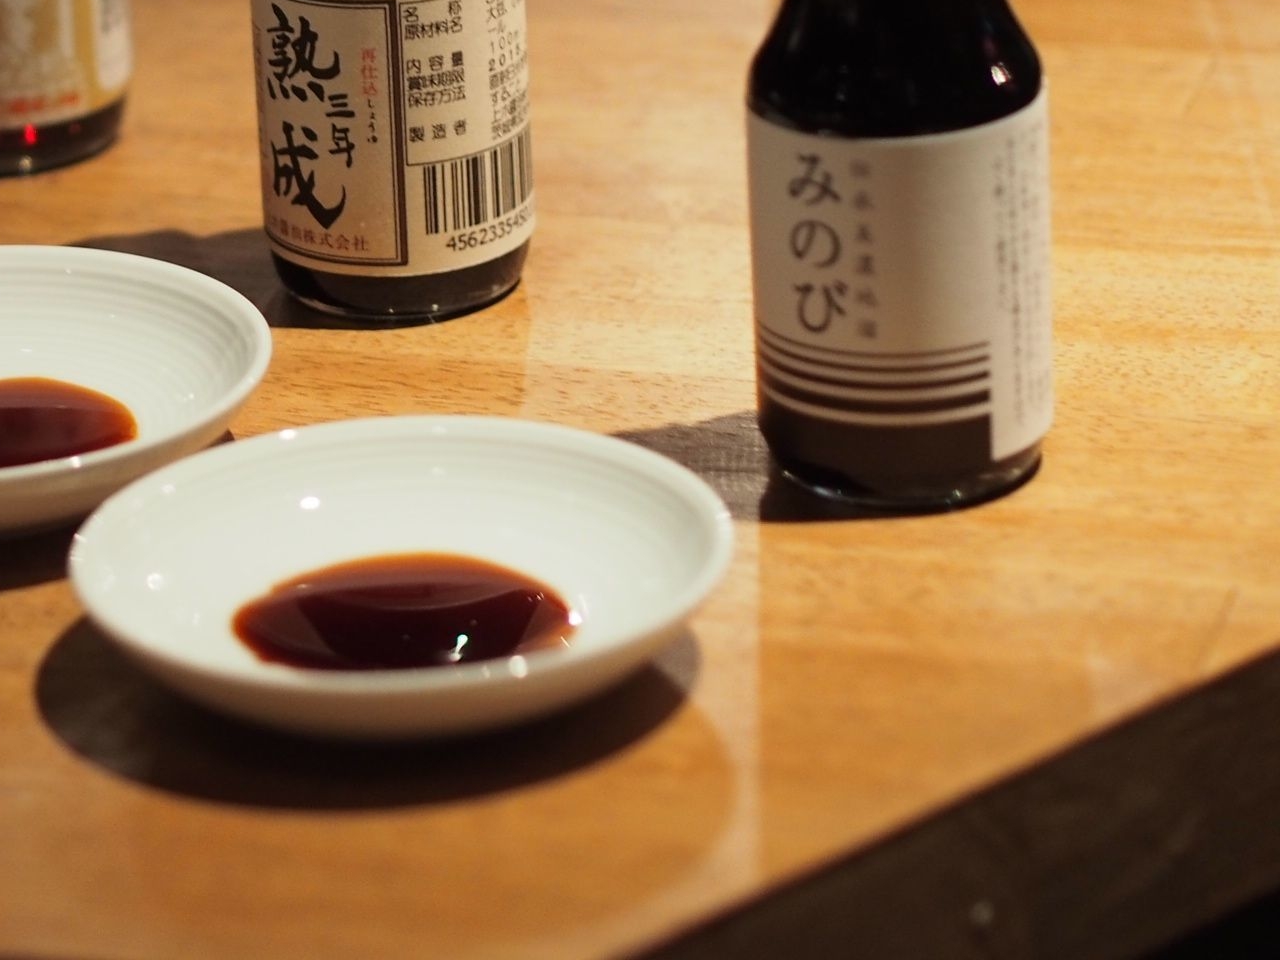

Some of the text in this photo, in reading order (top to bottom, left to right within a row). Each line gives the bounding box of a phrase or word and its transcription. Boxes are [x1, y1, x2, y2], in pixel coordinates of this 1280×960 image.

[266, 3, 346, 229] 熟成
[408, 85, 466, 109] 保存方法
